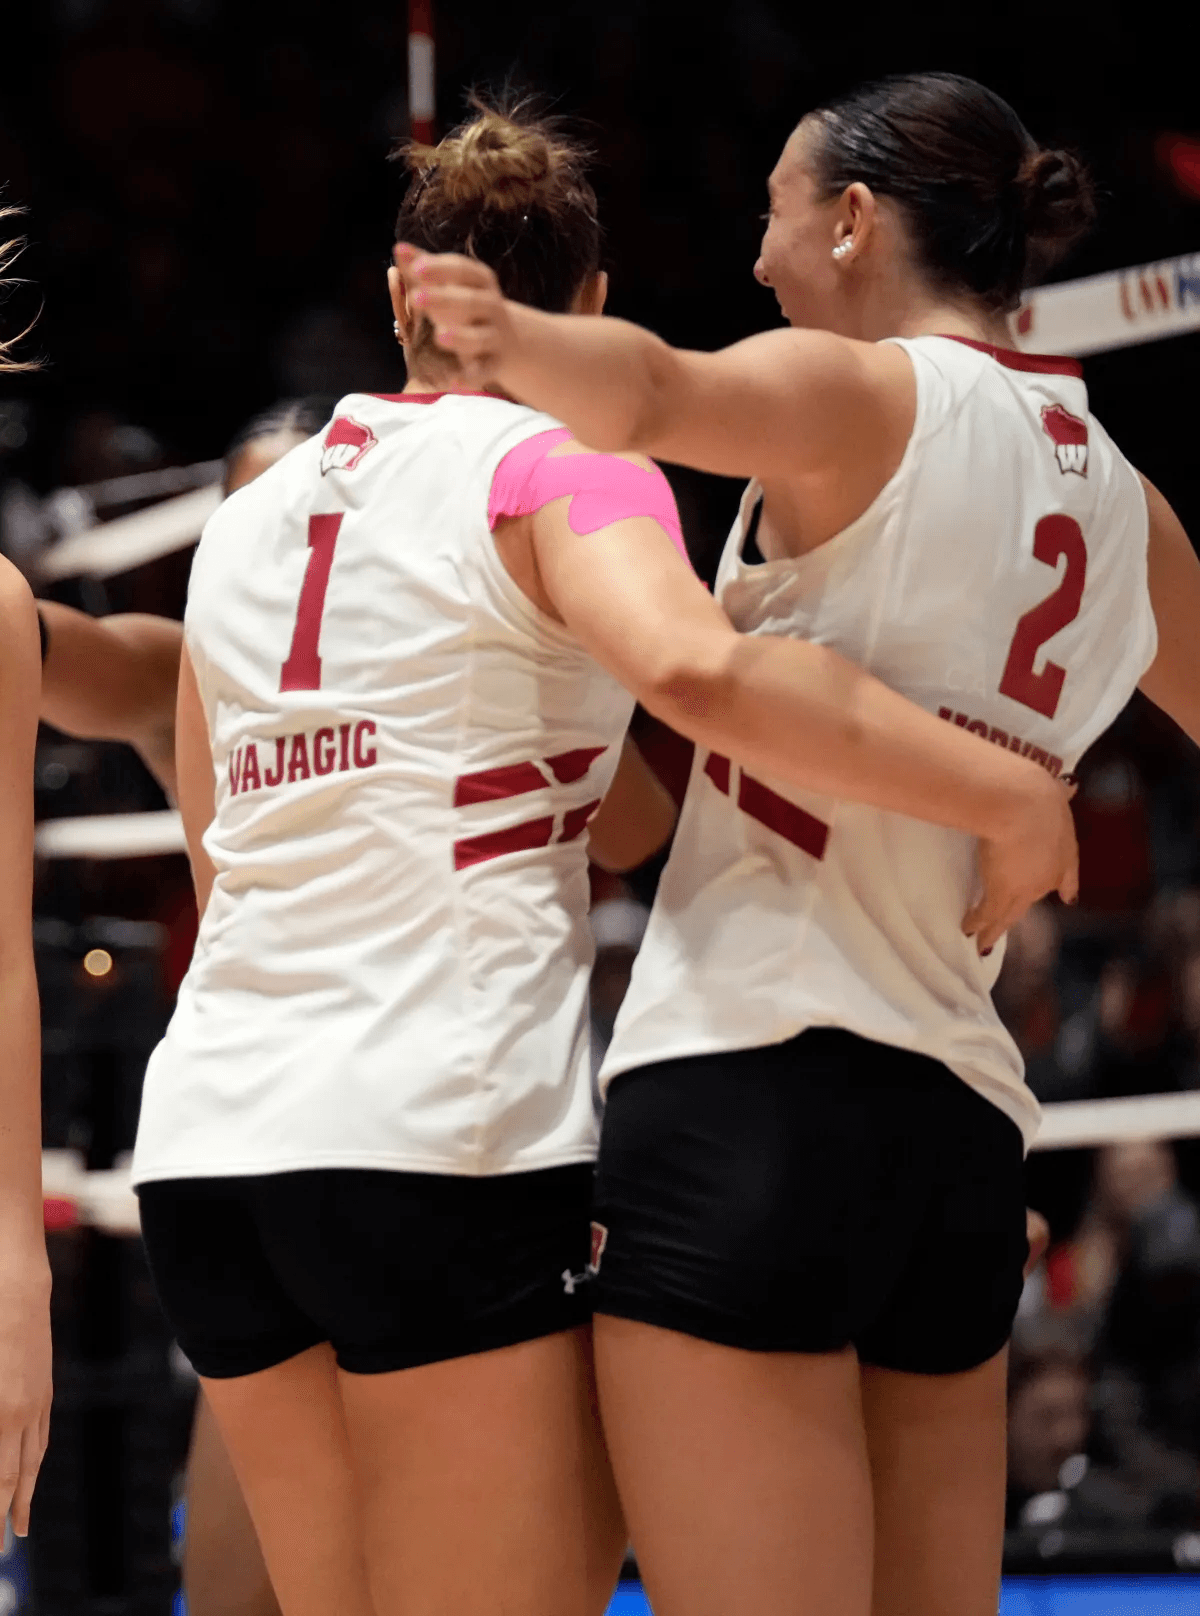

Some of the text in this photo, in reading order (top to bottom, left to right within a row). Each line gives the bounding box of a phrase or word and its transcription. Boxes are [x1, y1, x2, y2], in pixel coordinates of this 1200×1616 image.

[279, 512, 345, 693] 1
[999, 513, 1087, 720] 2
[229, 720, 377, 797] VAJAGIC
